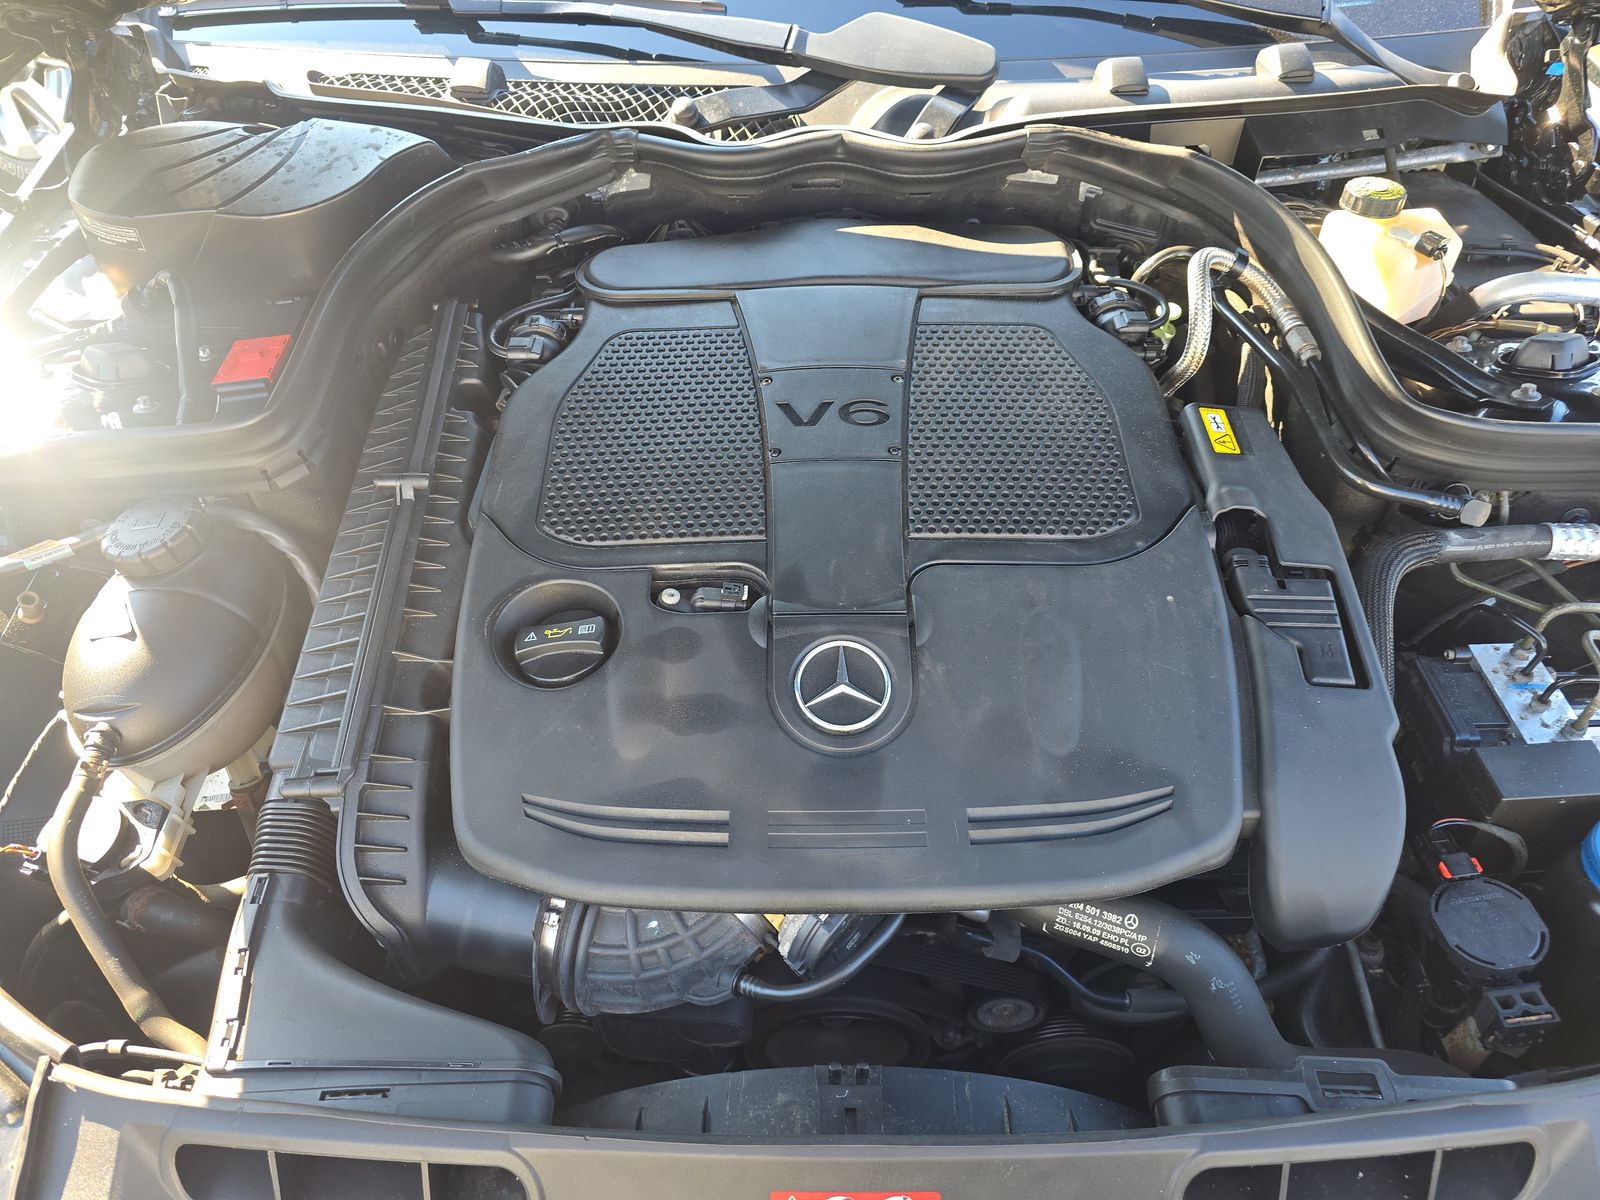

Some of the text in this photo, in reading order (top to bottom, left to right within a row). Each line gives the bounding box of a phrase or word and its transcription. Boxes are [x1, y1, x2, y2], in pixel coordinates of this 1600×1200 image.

[776, 399, 890, 426] V6
[1085, 905, 1100, 917] 501
[1102, 911, 1123, 924] 3982
[1083, 933, 1099, 942] YAP
[1120, 937, 1130, 947] PL
